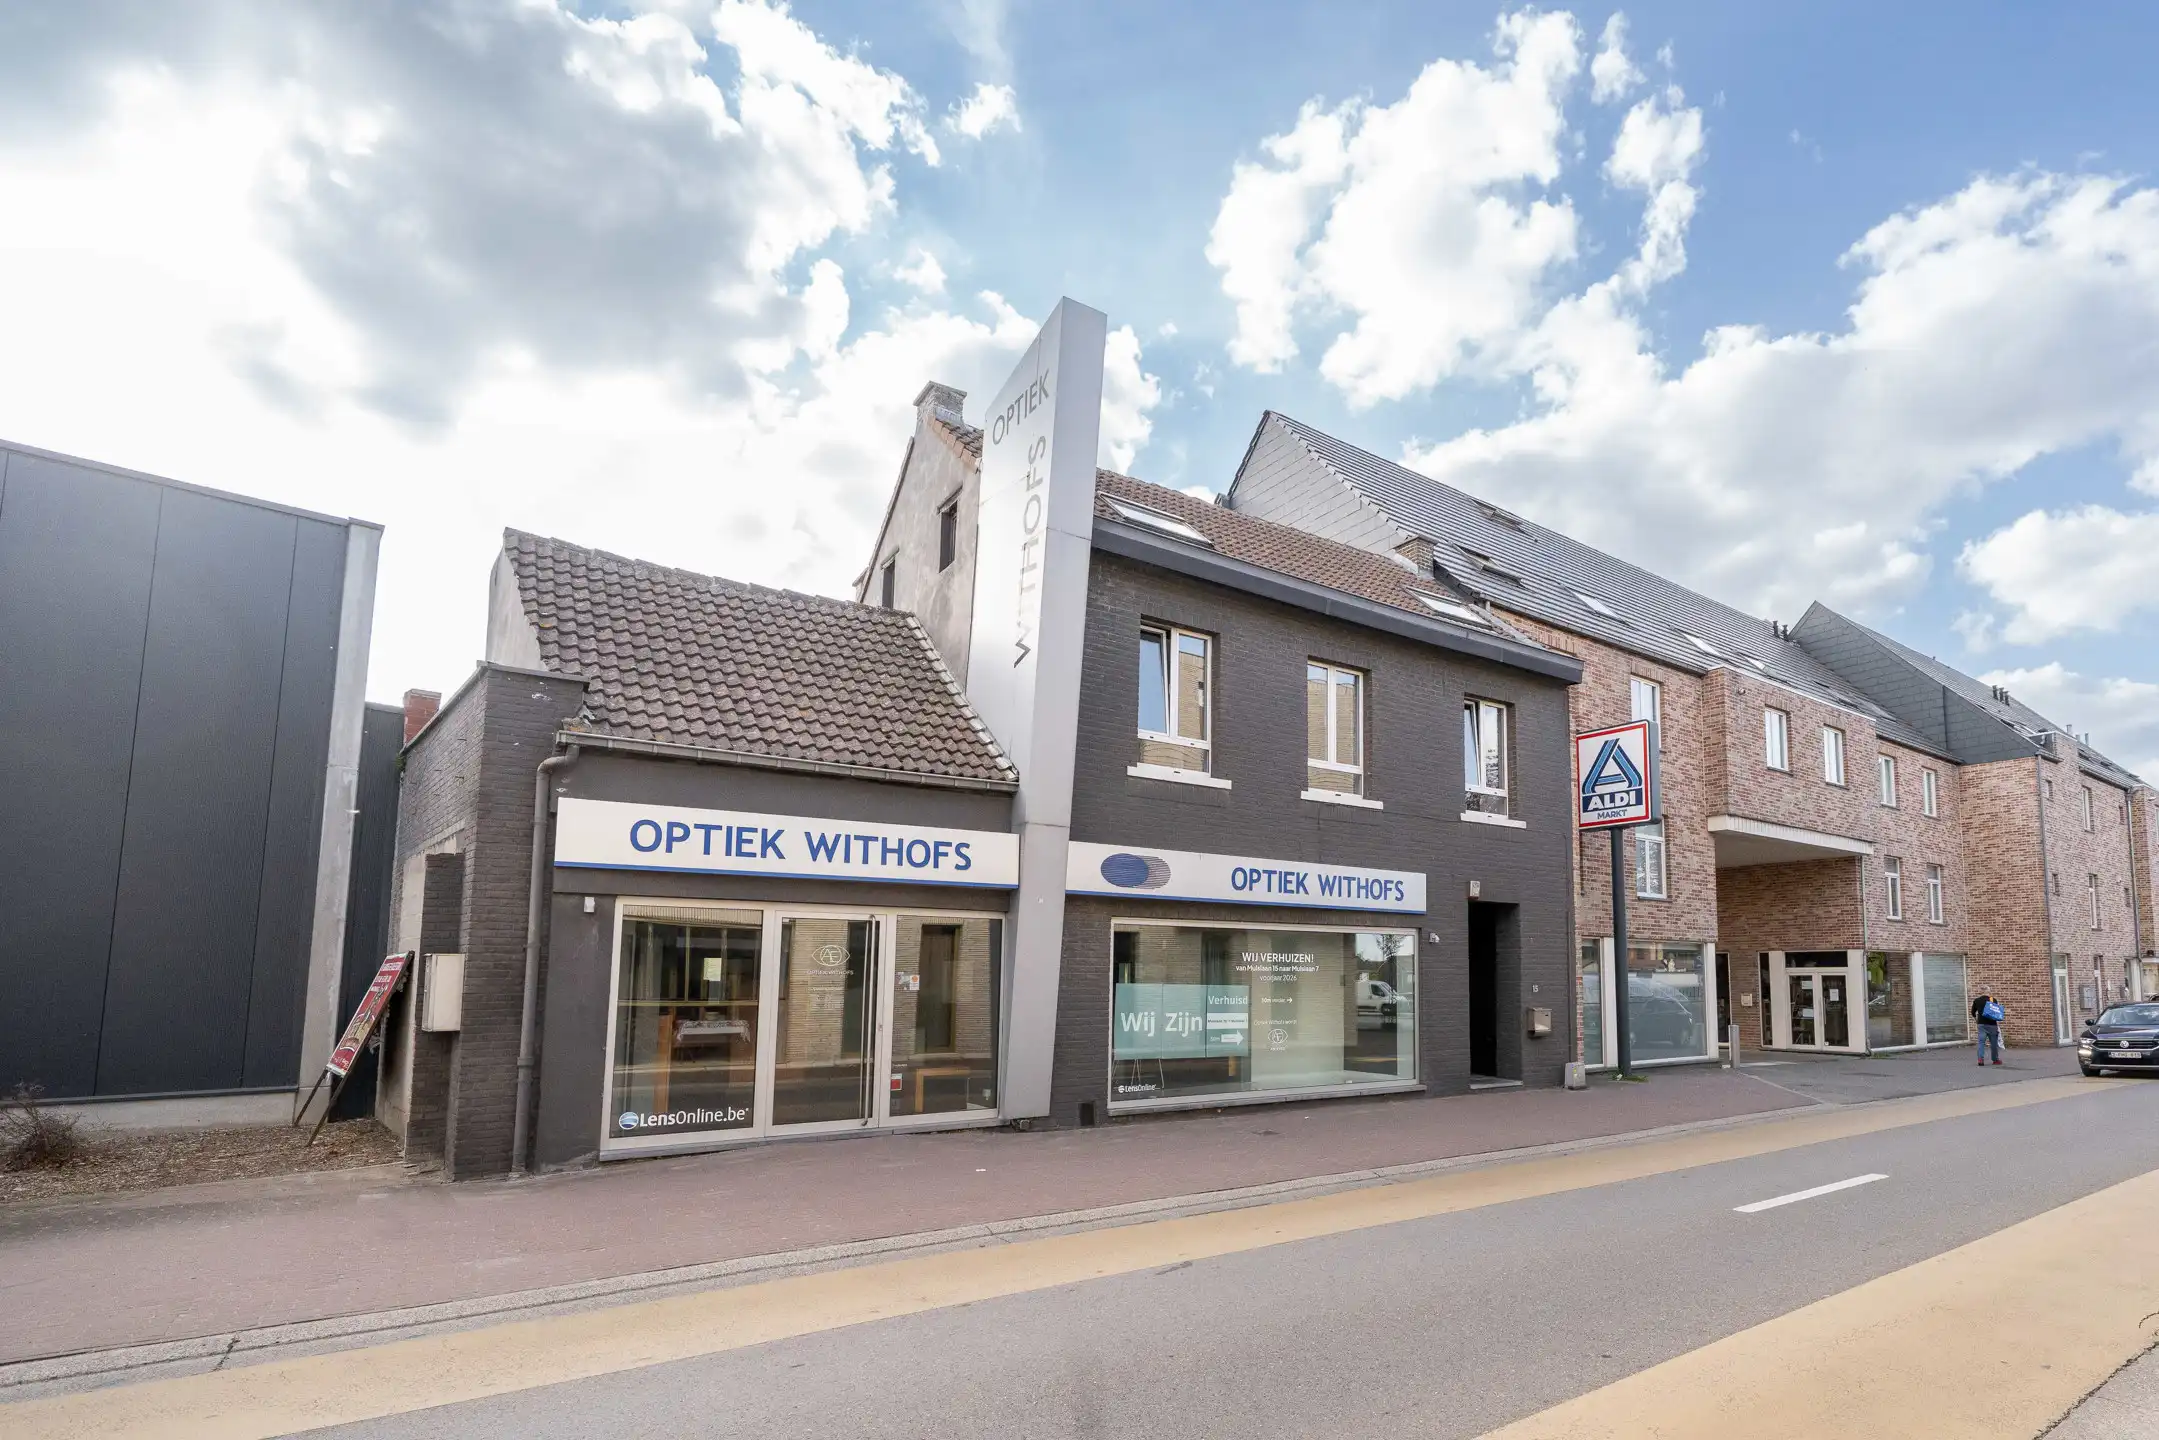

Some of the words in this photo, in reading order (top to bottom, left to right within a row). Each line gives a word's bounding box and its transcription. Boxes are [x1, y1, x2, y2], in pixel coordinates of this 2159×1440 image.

[993, 368, 1049, 445] OPTIEK
[1013, 435, 1047, 669] WTHOFS
[1587, 790, 1636, 811] ALDI
[1597, 809, 1627, 820] MARKT
[630, 819, 786, 860] OPTIEK
[804, 831, 972, 871] WITHOFS
[1231, 867, 1309, 895] OPTIEK
[1317, 874, 1405, 902] WITHOFS
[1242, 952, 1259, 962] WIJ
[1260, 953, 1314, 963] VERHUIZEN!
[1208, 996, 1248, 1005] Verhuisd
[1120, 1012, 1155, 1037] Wij
[1165, 1012, 1203, 1038] Zijn
